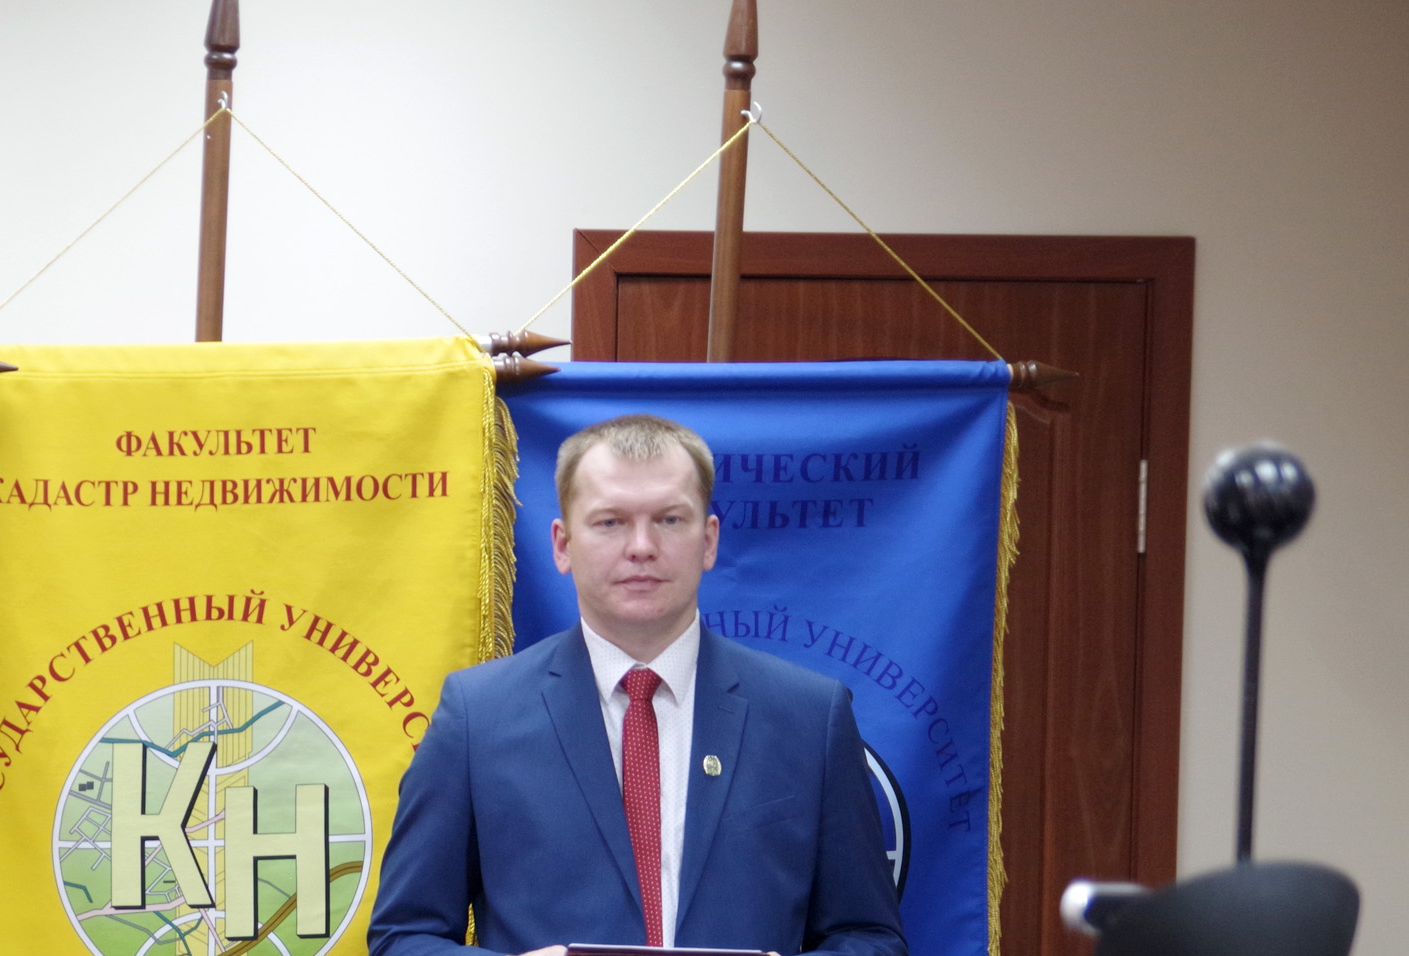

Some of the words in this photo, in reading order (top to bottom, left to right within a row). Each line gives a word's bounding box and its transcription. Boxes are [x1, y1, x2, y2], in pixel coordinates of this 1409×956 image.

[115, 427, 317, 457] ФАКУЛЬТЕТ
[712, 443, 921, 484] ИЧЕСКИЙ
[149, 471, 451, 511] НЕДВИЖИМОСТИ
[709, 498, 874, 530] УЛЬТЕТ
[279, 604, 430, 752] УНИВЕРС
[803, 619, 973, 833] УНИВЕРСИТЕТ
